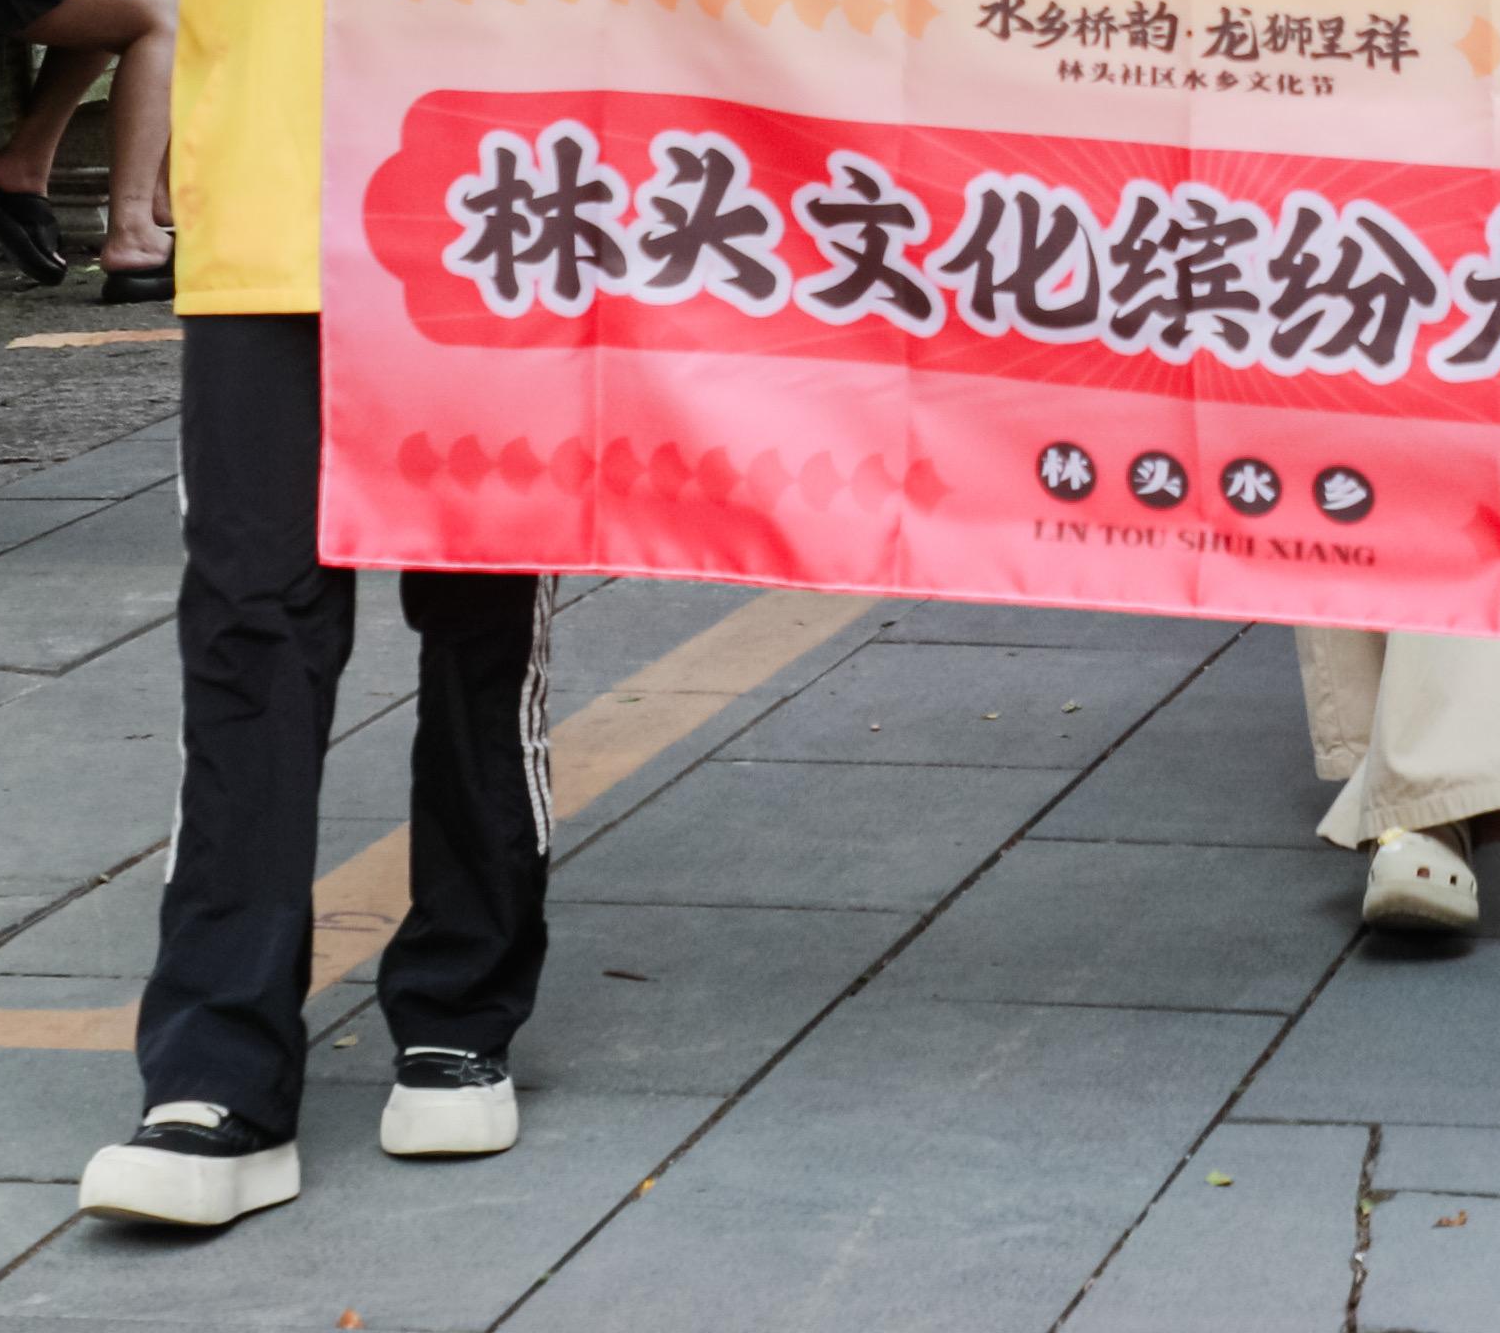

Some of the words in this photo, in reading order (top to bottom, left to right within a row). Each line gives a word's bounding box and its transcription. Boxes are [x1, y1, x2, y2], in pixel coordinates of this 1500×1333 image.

[1057, 57, 1336, 97] 林头社区水乡文化节
[1040, 446, 1368, 513] 林头水乡
[1034, 518, 1090, 544] LIN
[1100, 523, 1166, 551] TOU
[1177, 530, 1256, 559] SHUI
[1267, 537, 1377, 568] XIANG
